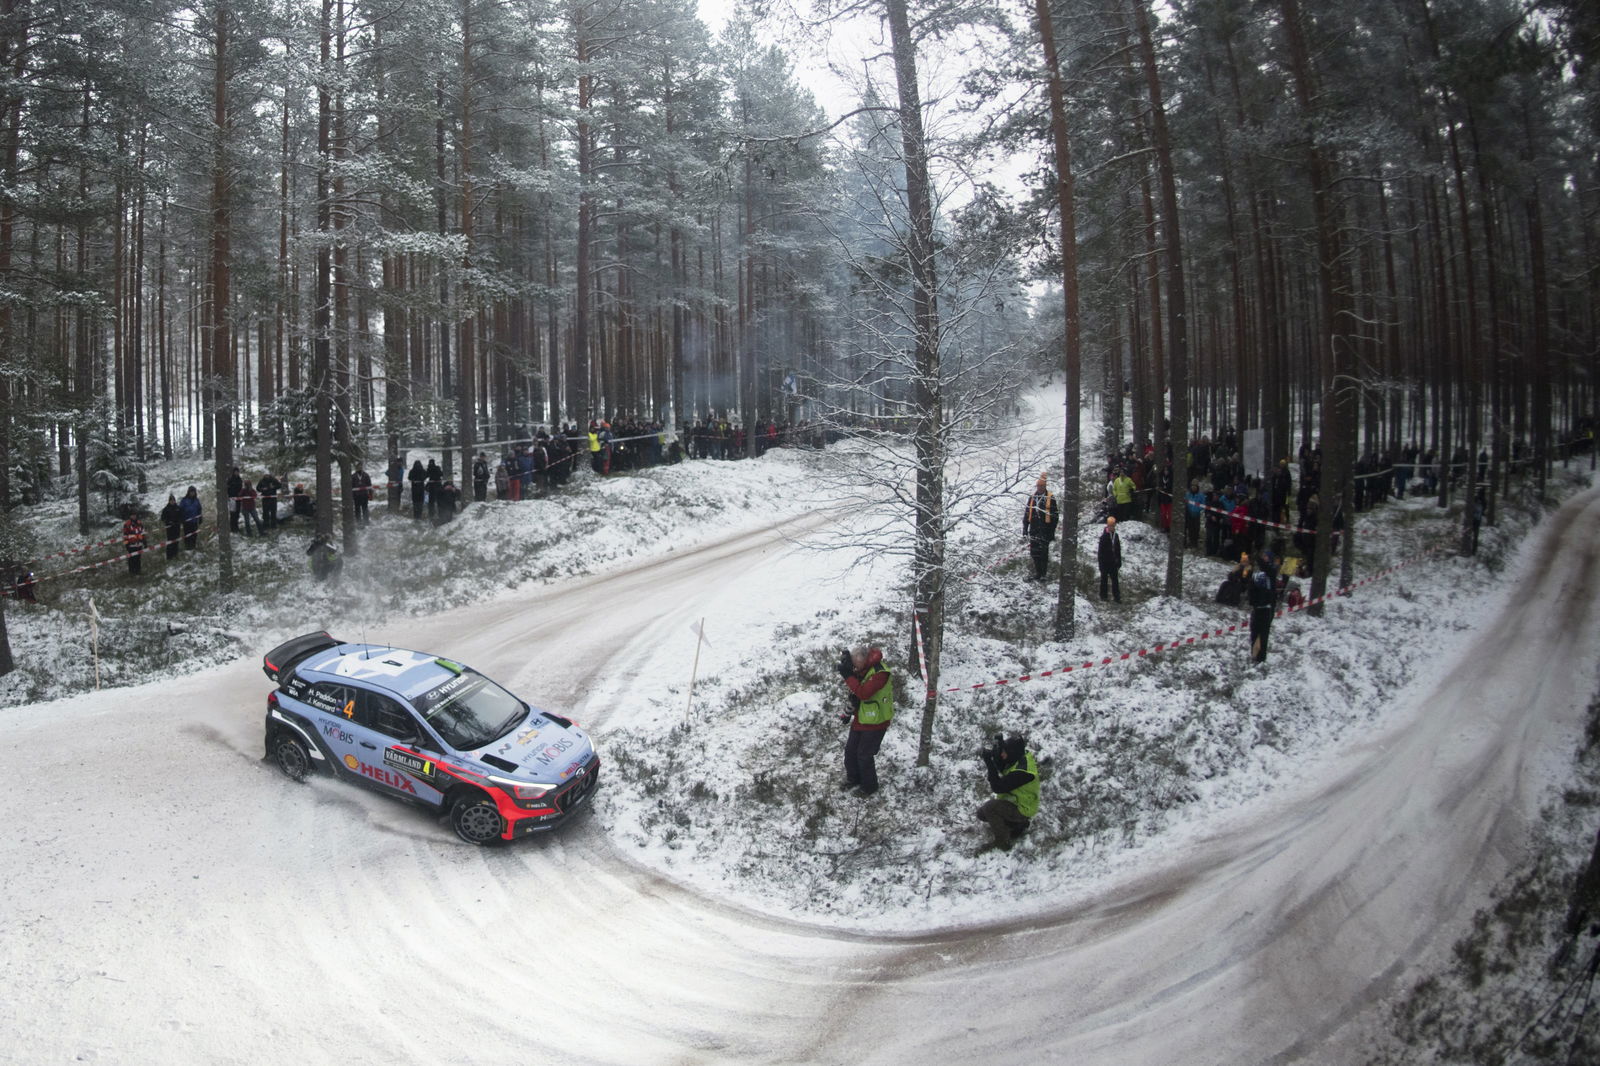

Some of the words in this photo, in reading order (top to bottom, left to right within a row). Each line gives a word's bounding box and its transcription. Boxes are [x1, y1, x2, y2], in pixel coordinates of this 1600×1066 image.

[343, 699, 356, 720] 4
[323, 725, 354, 745] MOBIS
[536, 737, 574, 766] MOBIS
[361, 761, 417, 795] HELIX
[422, 760, 431, 776] 4
